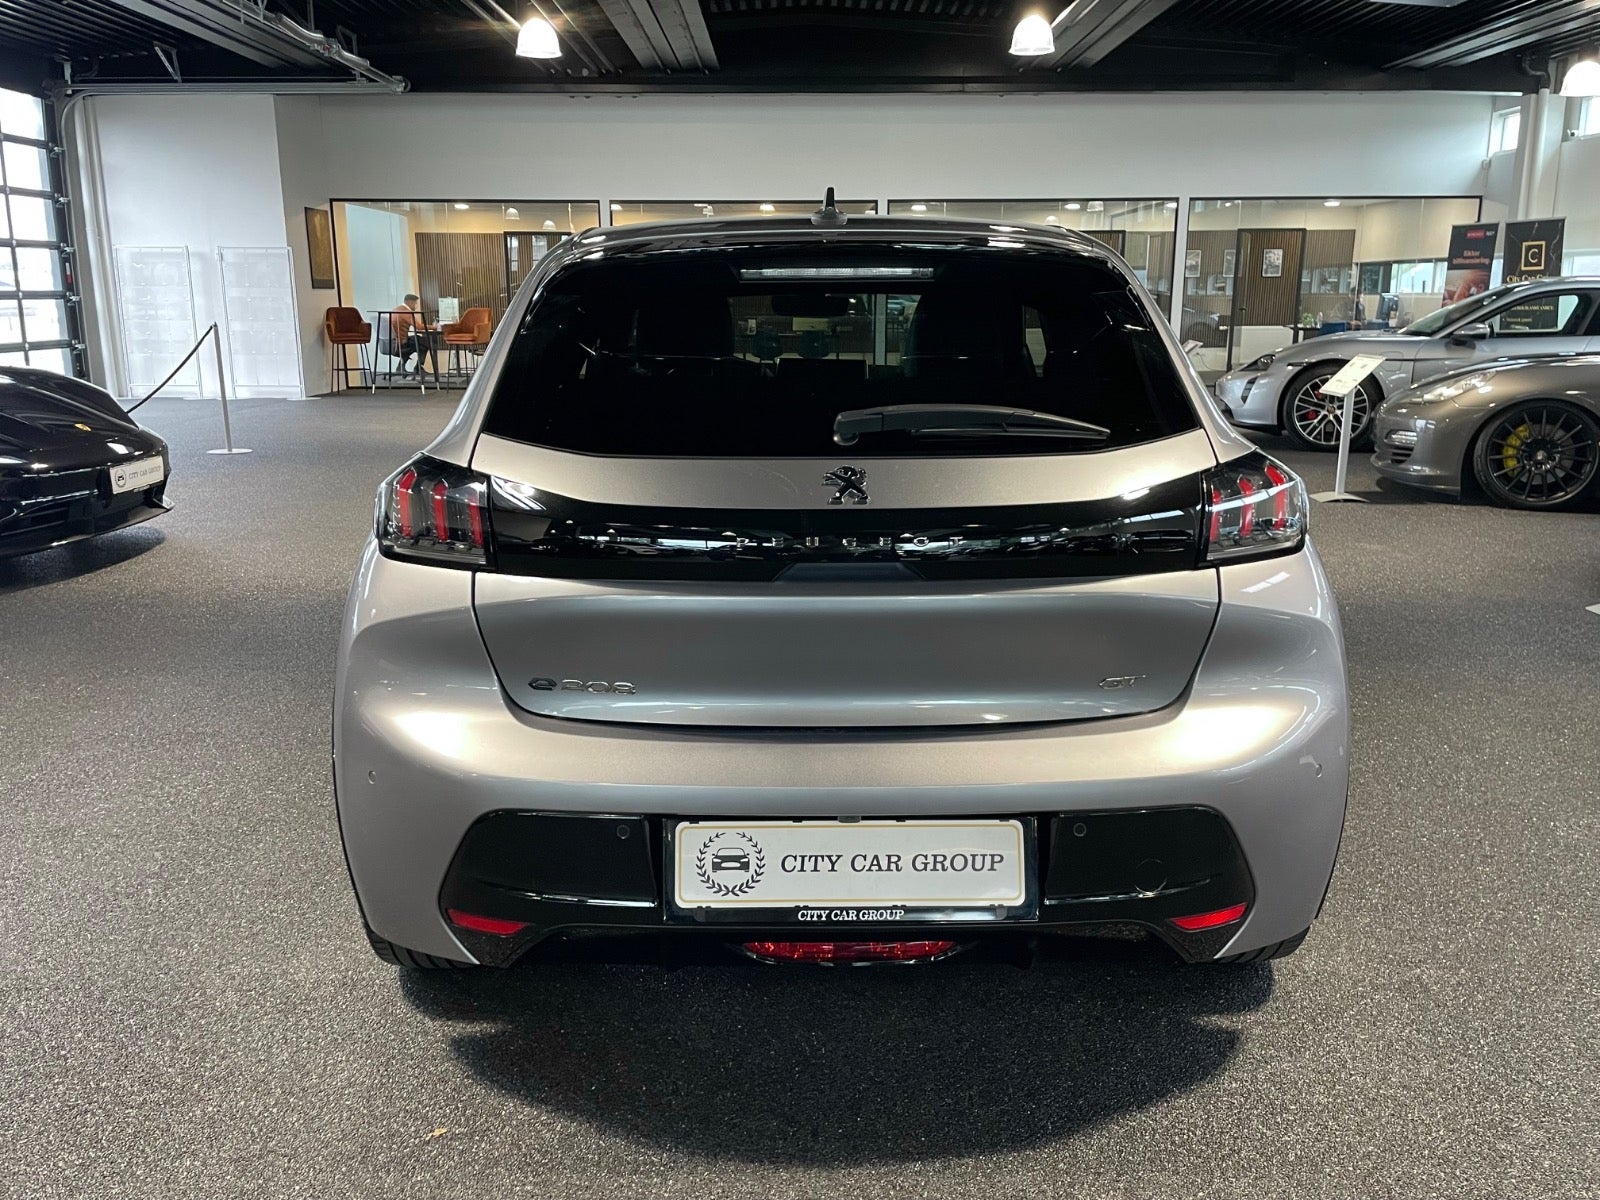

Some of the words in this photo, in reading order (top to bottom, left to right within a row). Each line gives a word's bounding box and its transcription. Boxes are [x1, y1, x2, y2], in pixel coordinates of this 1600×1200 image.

[1528, 248, 1539, 263] C
[736, 536, 963, 548] PEUGEOT
[1098, 674, 1147, 690] GT
[780, 853, 844, 873] CITY
[850, 853, 903, 873] CAR
[911, 852, 1005, 873] GROUP
[797, 909, 830, 921] CITY
[831, 909, 858, 921] CAR
[859, 909, 905, 920] GROUP
